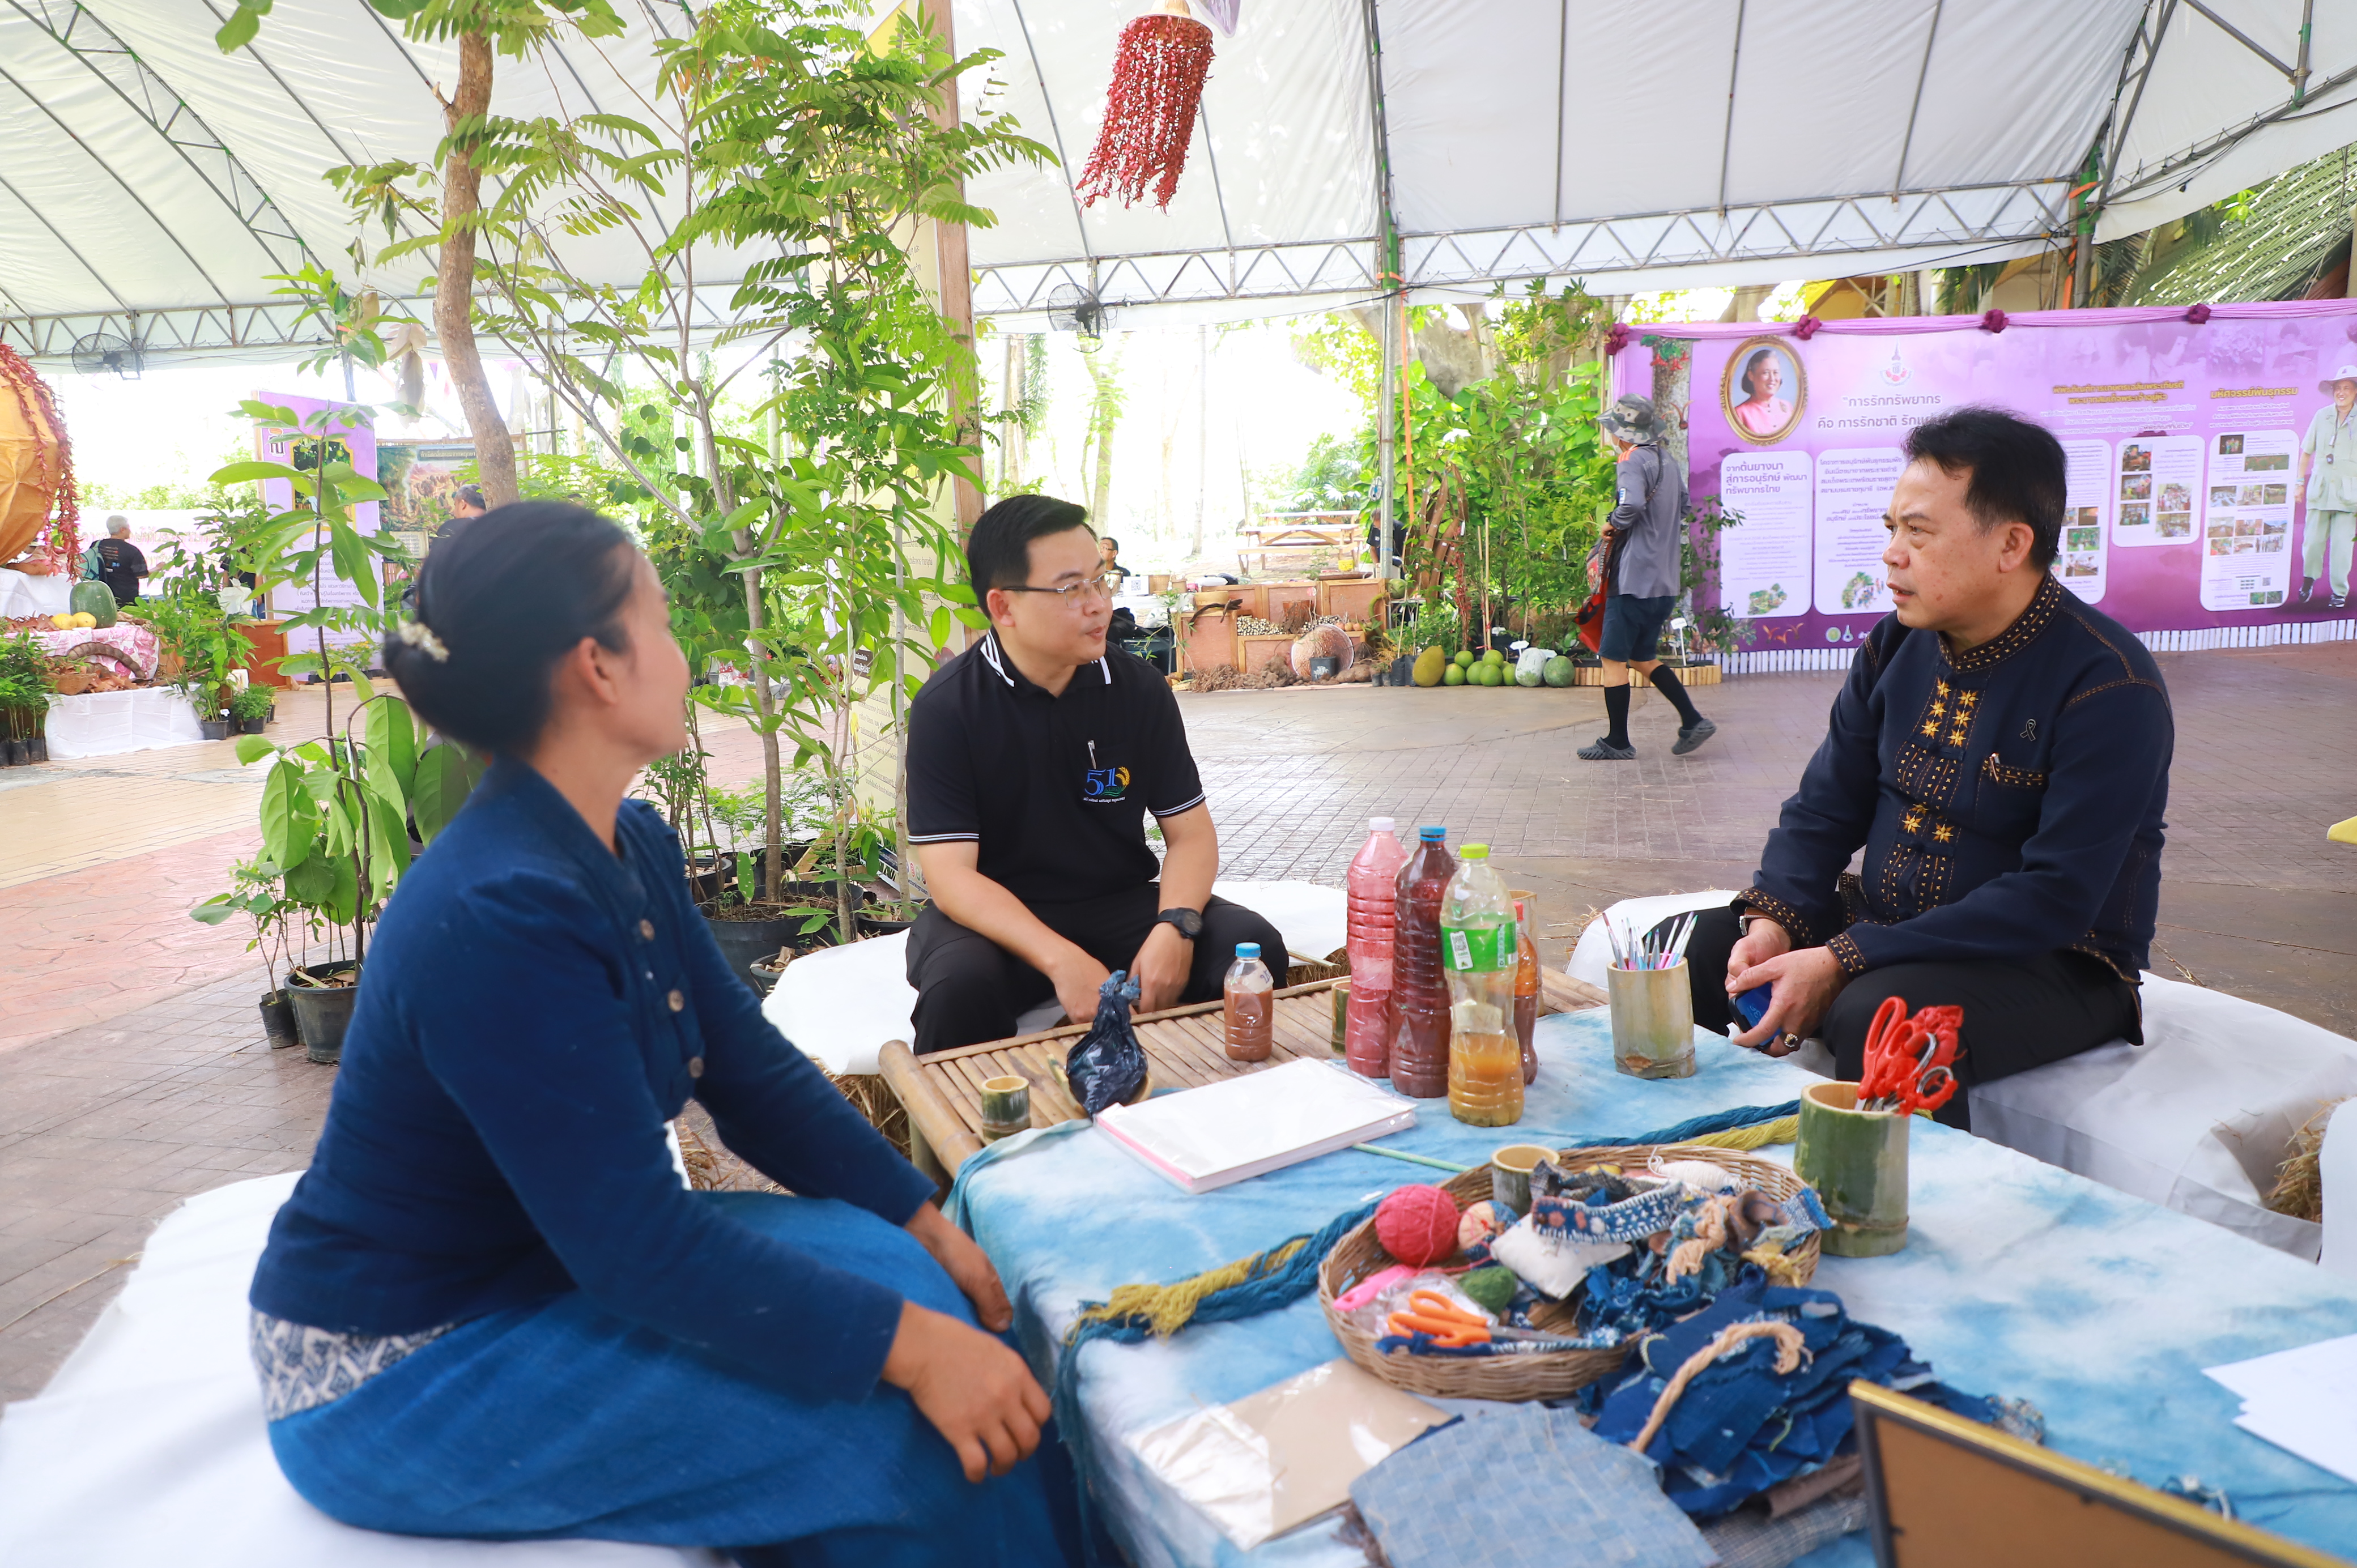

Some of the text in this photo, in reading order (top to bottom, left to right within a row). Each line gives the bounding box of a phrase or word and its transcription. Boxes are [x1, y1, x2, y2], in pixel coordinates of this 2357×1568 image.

[2211, 387, 2298, 399] มหัศจรรย์พันธุกรรม
[1818, 417, 1833, 428] คือ
[1839, 415, 1897, 428] การรักชาติ
[1726, 461, 1783, 471] จากต้นยางนา
[1726, 472, 1780, 485] สู่การอนุรักษ์
[1726, 485, 1780, 494] ทรัพยากรไทย
[1084, 768, 1117, 795] 51
